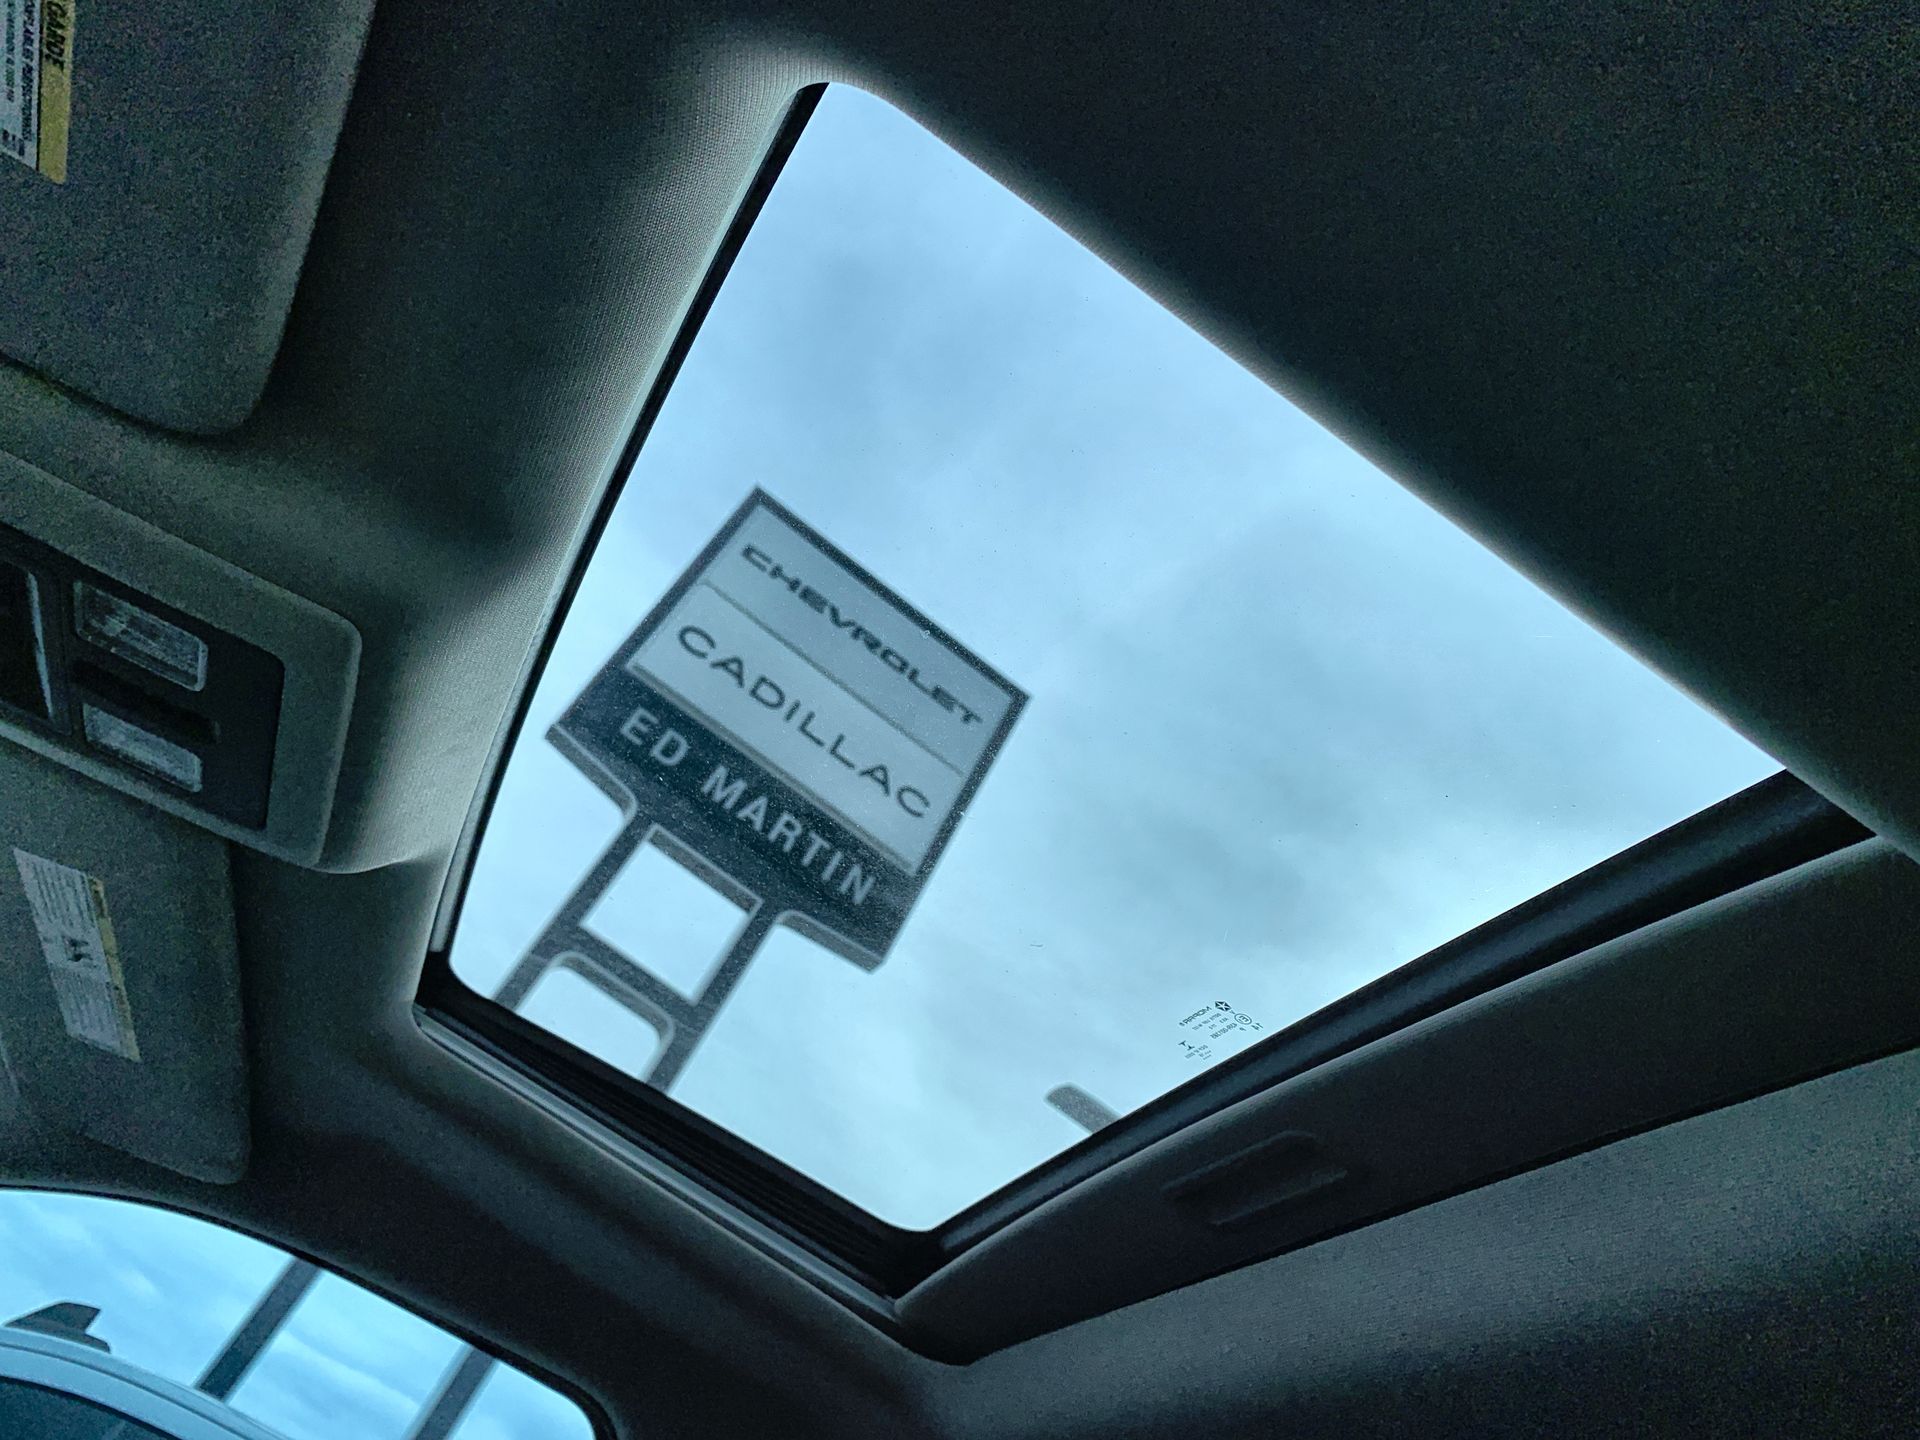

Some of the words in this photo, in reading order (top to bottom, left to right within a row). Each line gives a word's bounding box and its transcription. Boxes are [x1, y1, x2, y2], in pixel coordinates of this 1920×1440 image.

[45, 1, 66, 71] GARDE
[678, 625, 931, 818] CADILLAC
[742, 545, 983, 727] CHEVROLET
[619, 706, 688, 766] ED
[702, 765, 877, 907] MARTIN
